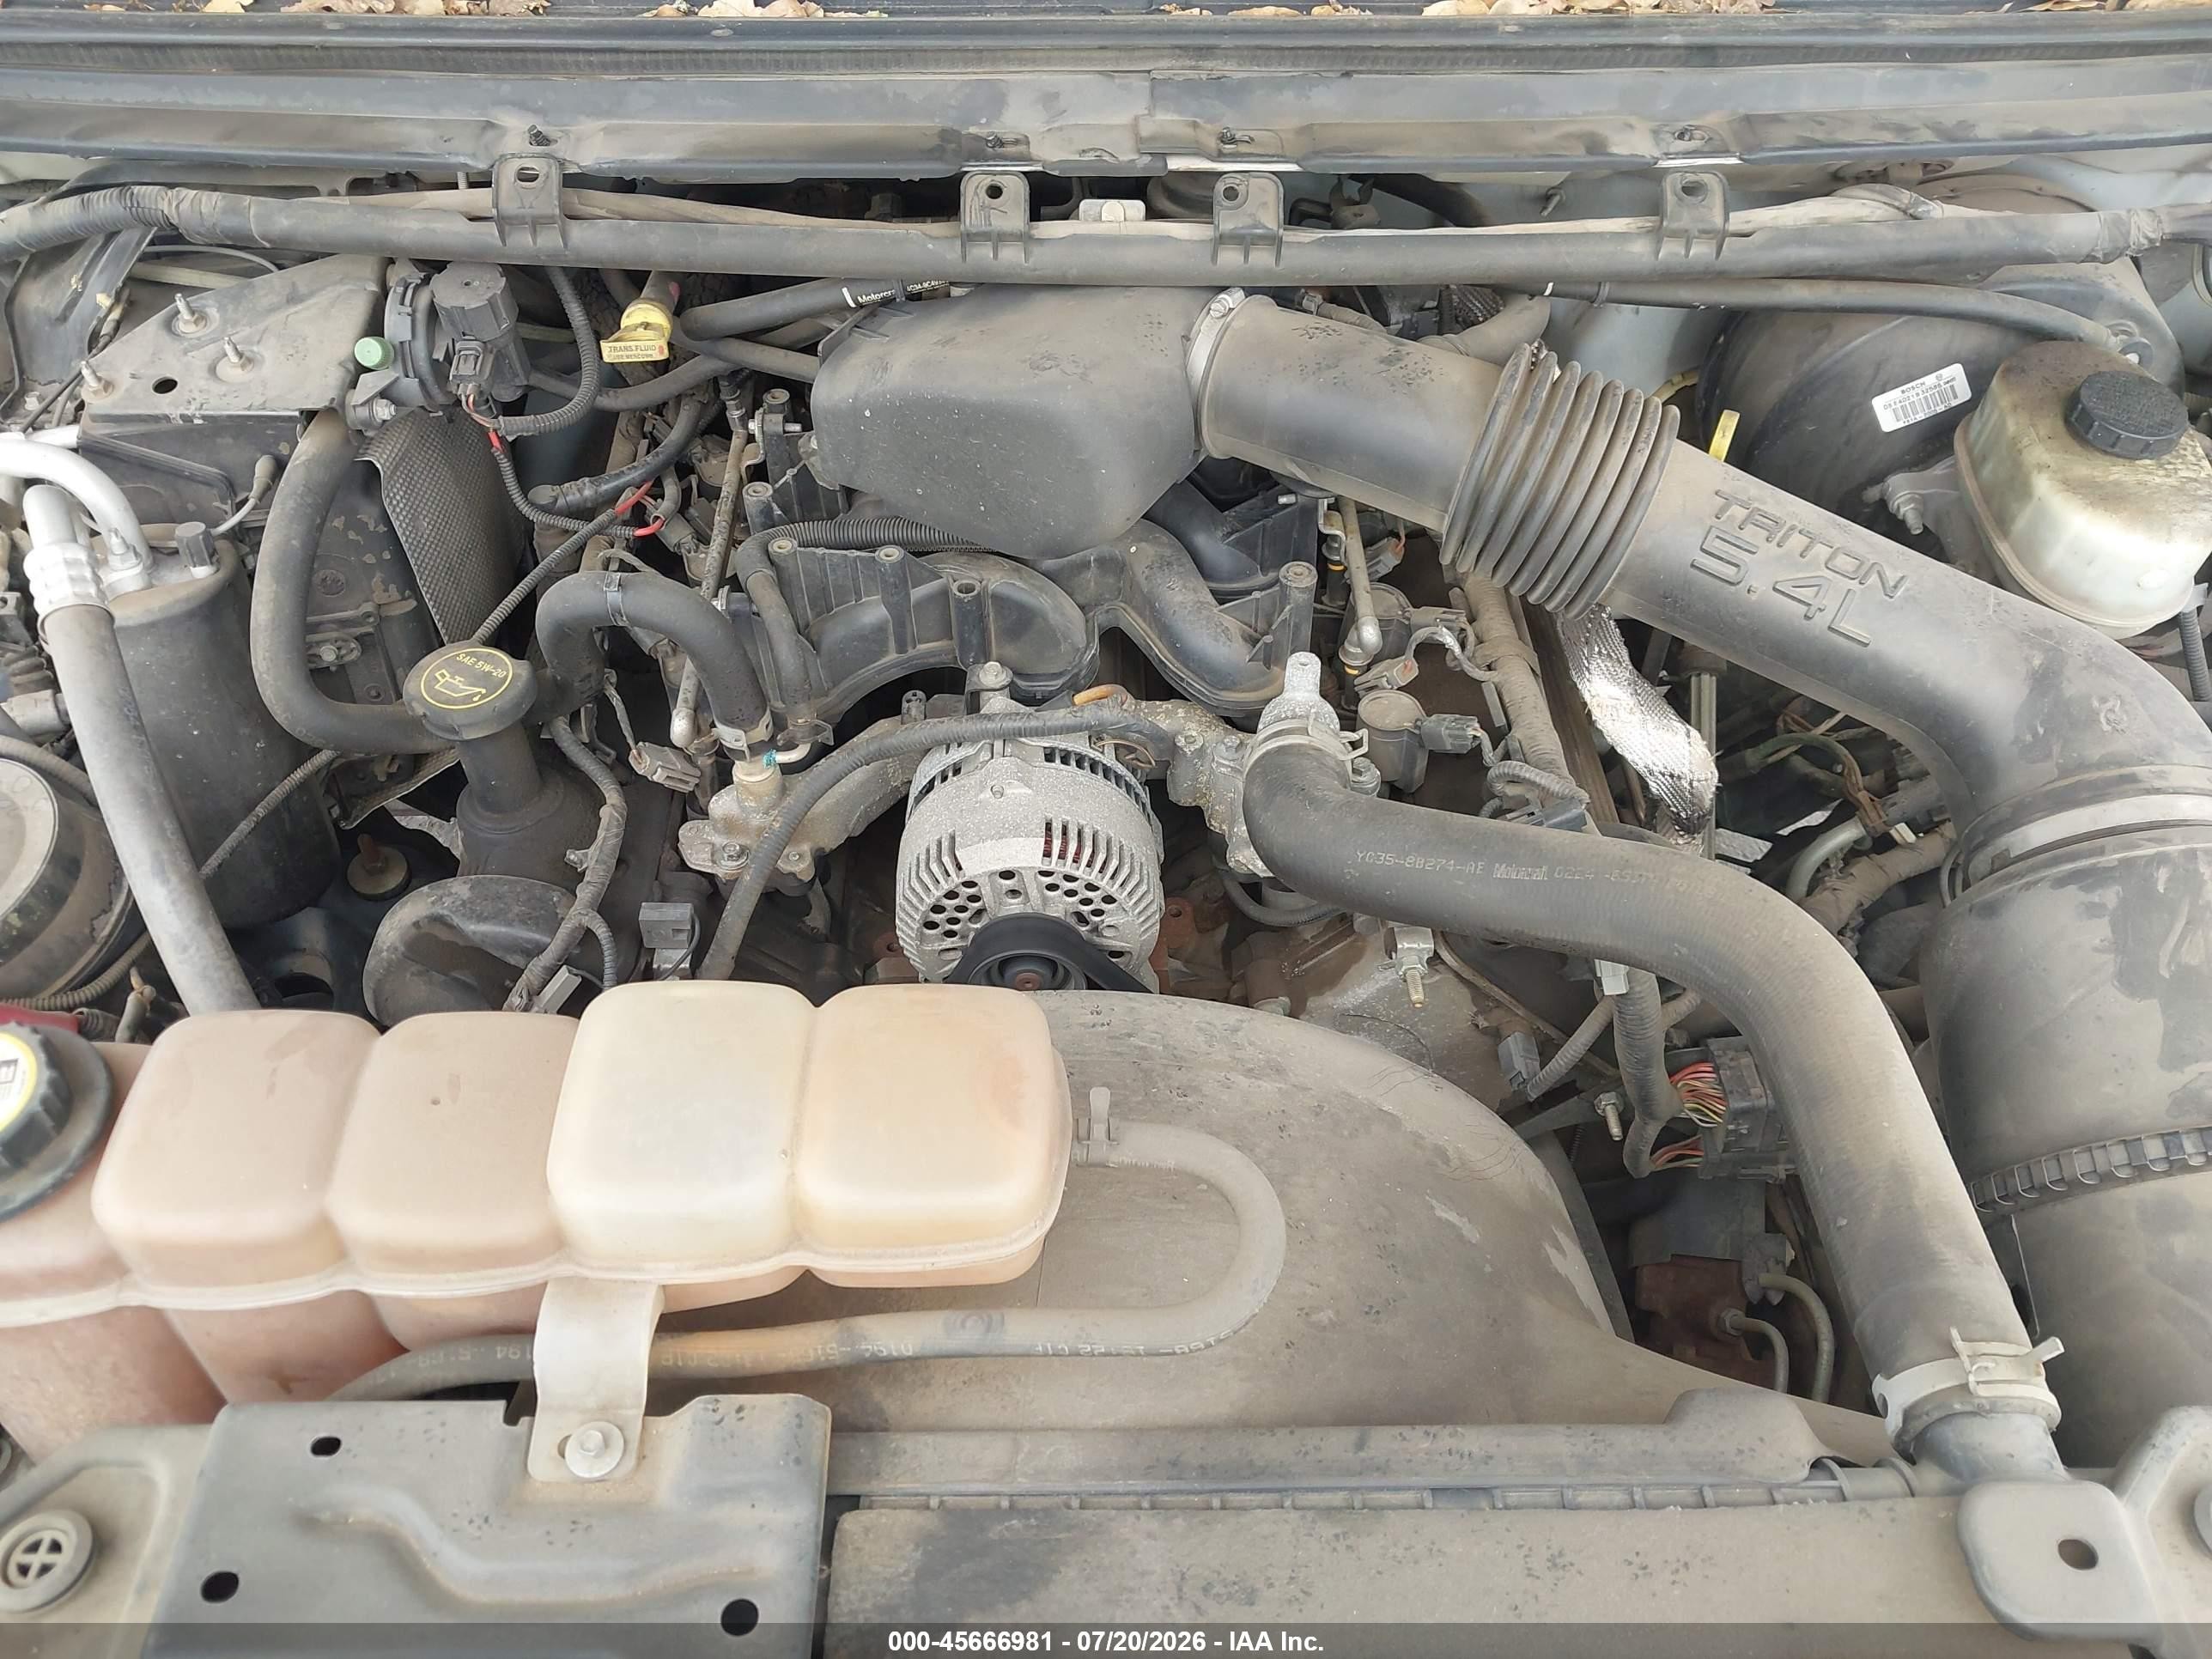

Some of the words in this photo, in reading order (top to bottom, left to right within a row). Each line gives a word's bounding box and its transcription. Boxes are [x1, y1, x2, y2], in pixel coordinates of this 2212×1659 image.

[1900, 381, 1926, 395] BOSCH
[1715, 489, 1909, 599] TRITON
[1690, 526, 1872, 647] 5.4L
[457, 653, 477, 666] SAE
[475, 660, 507, 678] 5W-20
